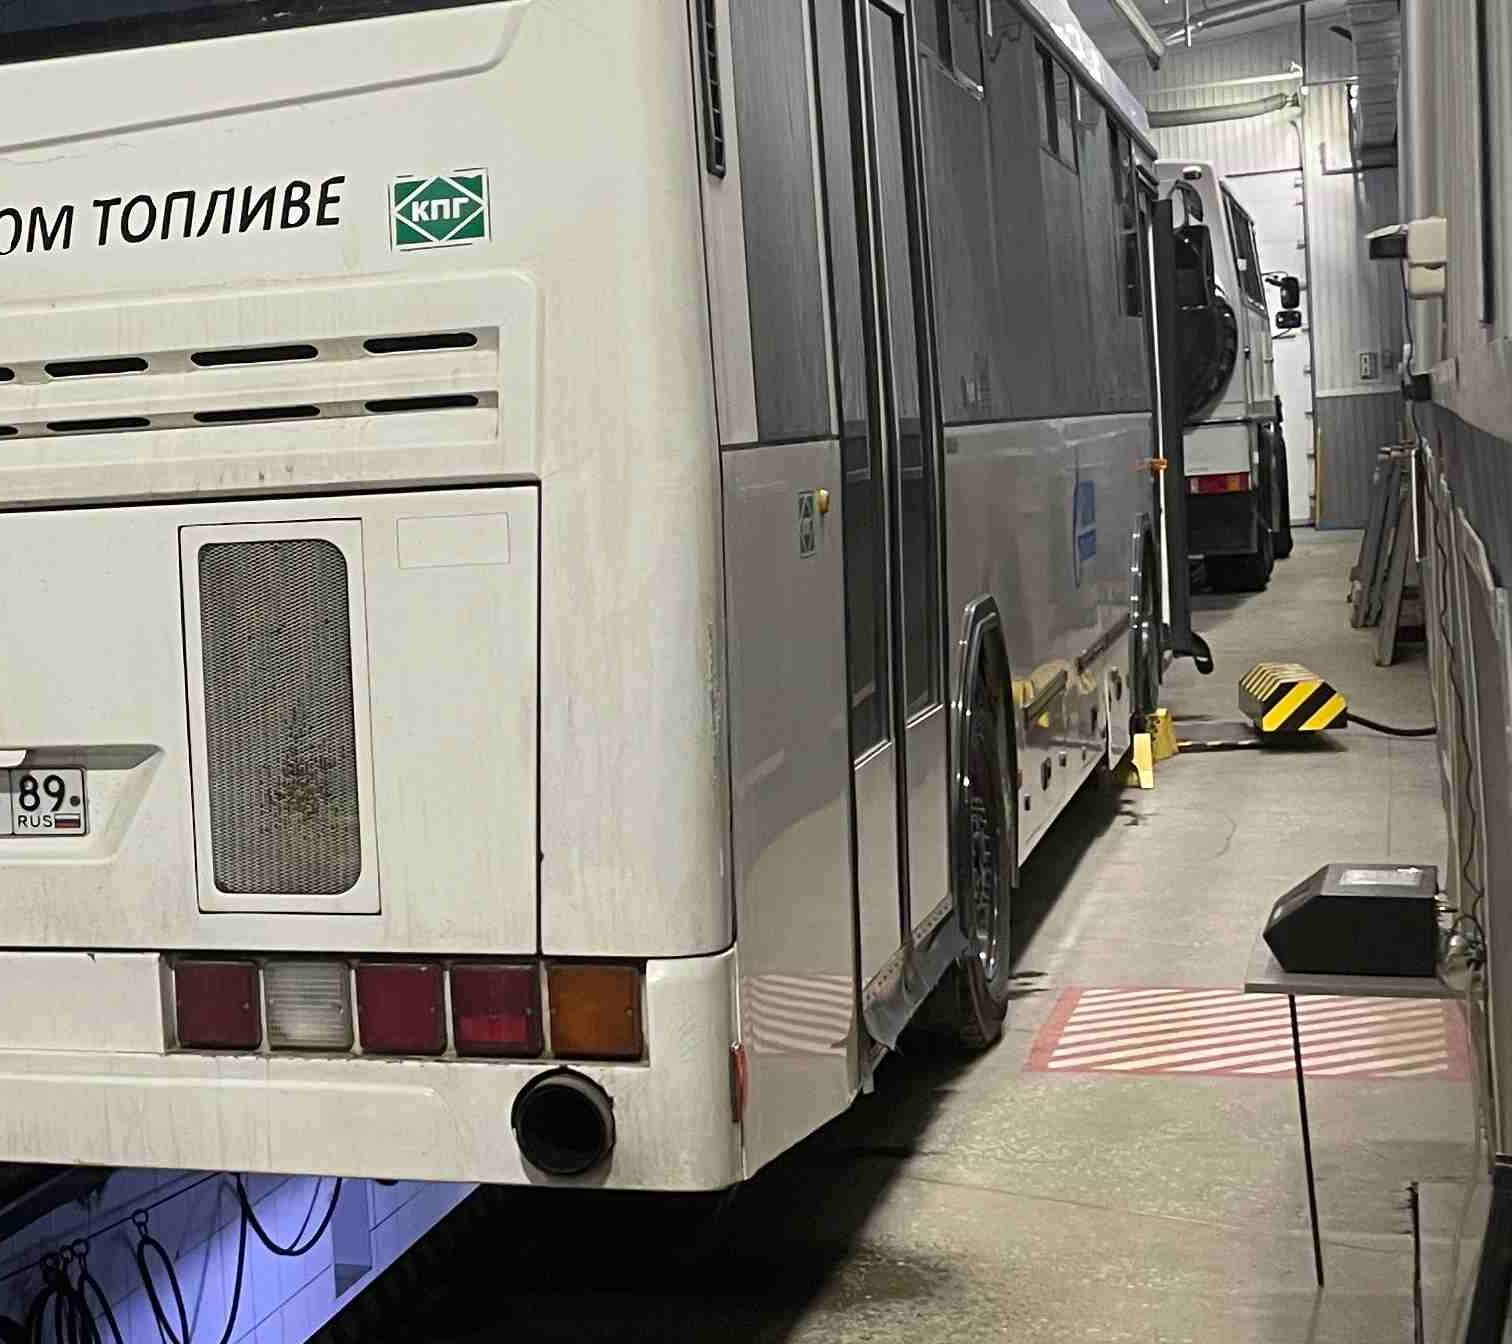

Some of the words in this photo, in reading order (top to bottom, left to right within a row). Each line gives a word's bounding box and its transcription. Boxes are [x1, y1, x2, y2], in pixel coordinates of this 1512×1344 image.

[93, 175, 346, 247] ТОПЛИВЕ
[411, 196, 470, 223] КПГ
[18, 774, 66, 812] 89
[17, 814, 53, 829] RUS
